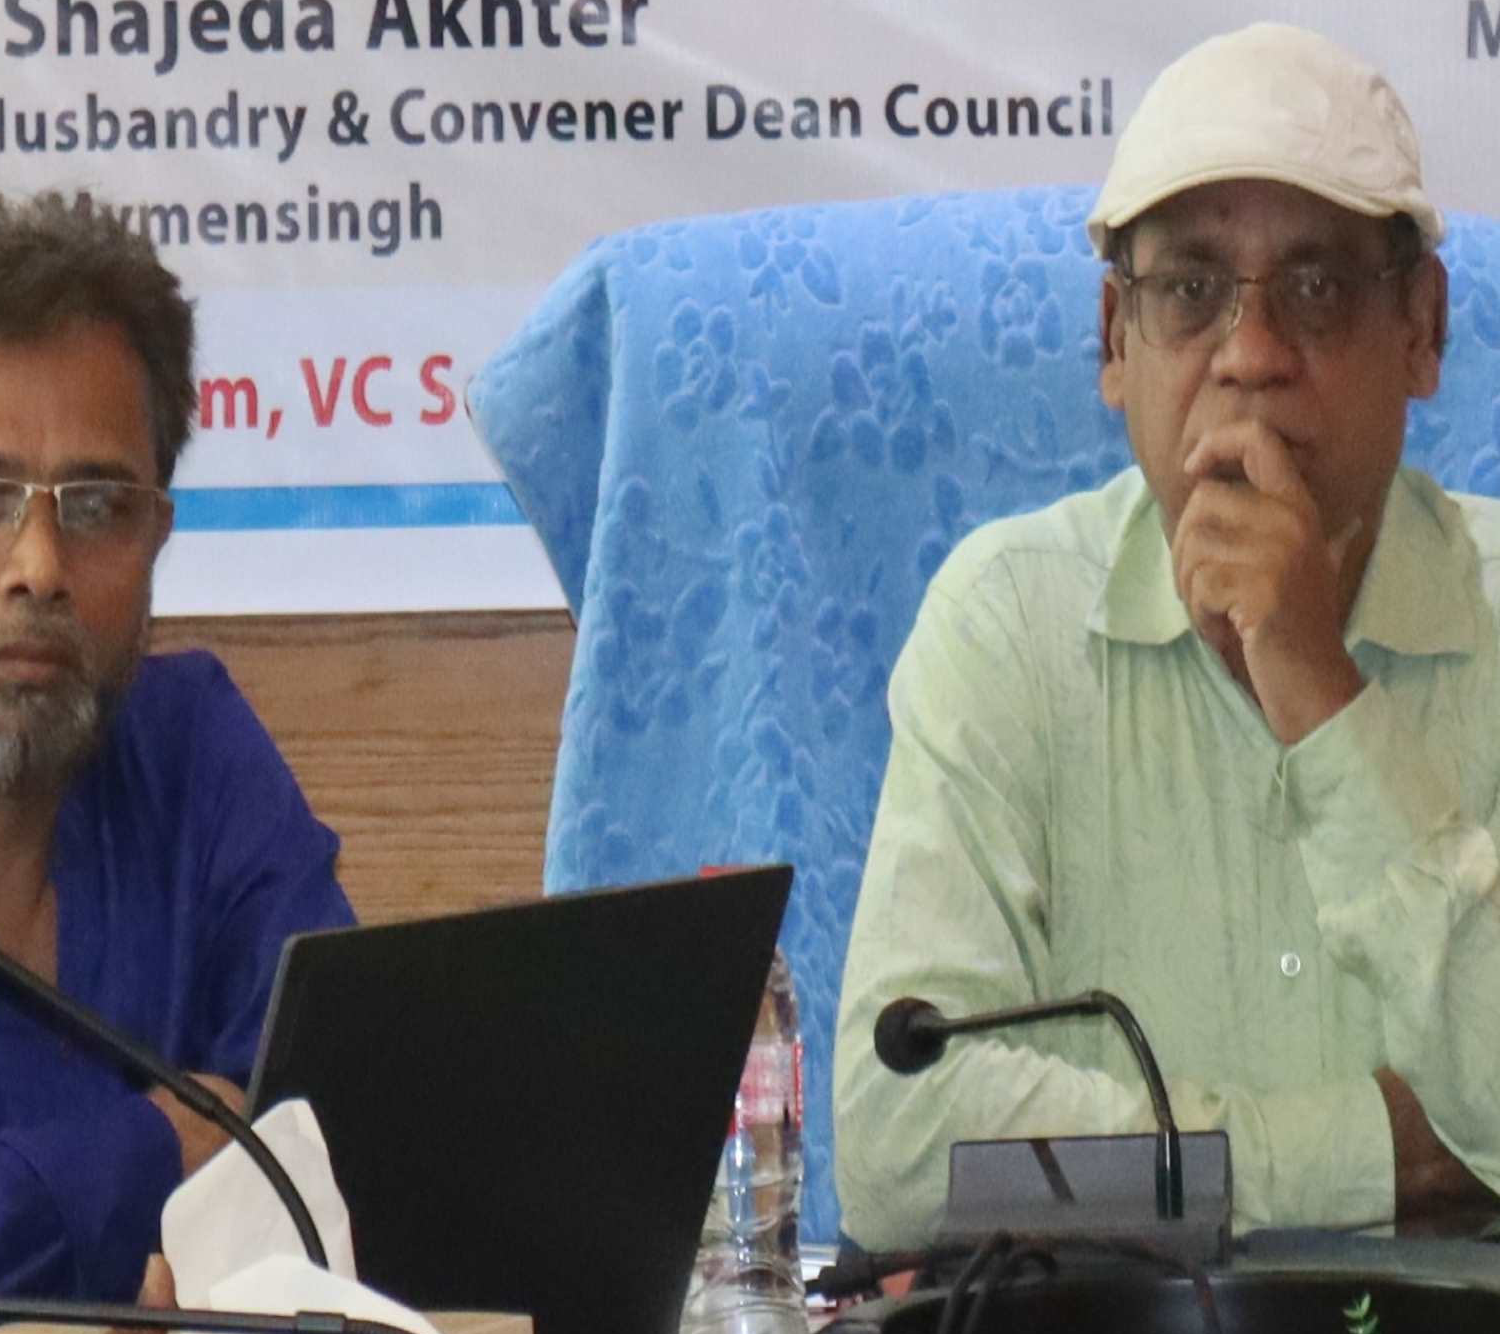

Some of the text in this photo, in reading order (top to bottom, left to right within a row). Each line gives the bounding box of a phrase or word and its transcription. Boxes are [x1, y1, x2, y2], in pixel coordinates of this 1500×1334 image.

[328, 90, 369, 145] &
[391, 89, 683, 144] Convener
[706, 85, 861, 140] Dean
[885, 79, 1112, 137] Council
[301, 356, 392, 427] VC
